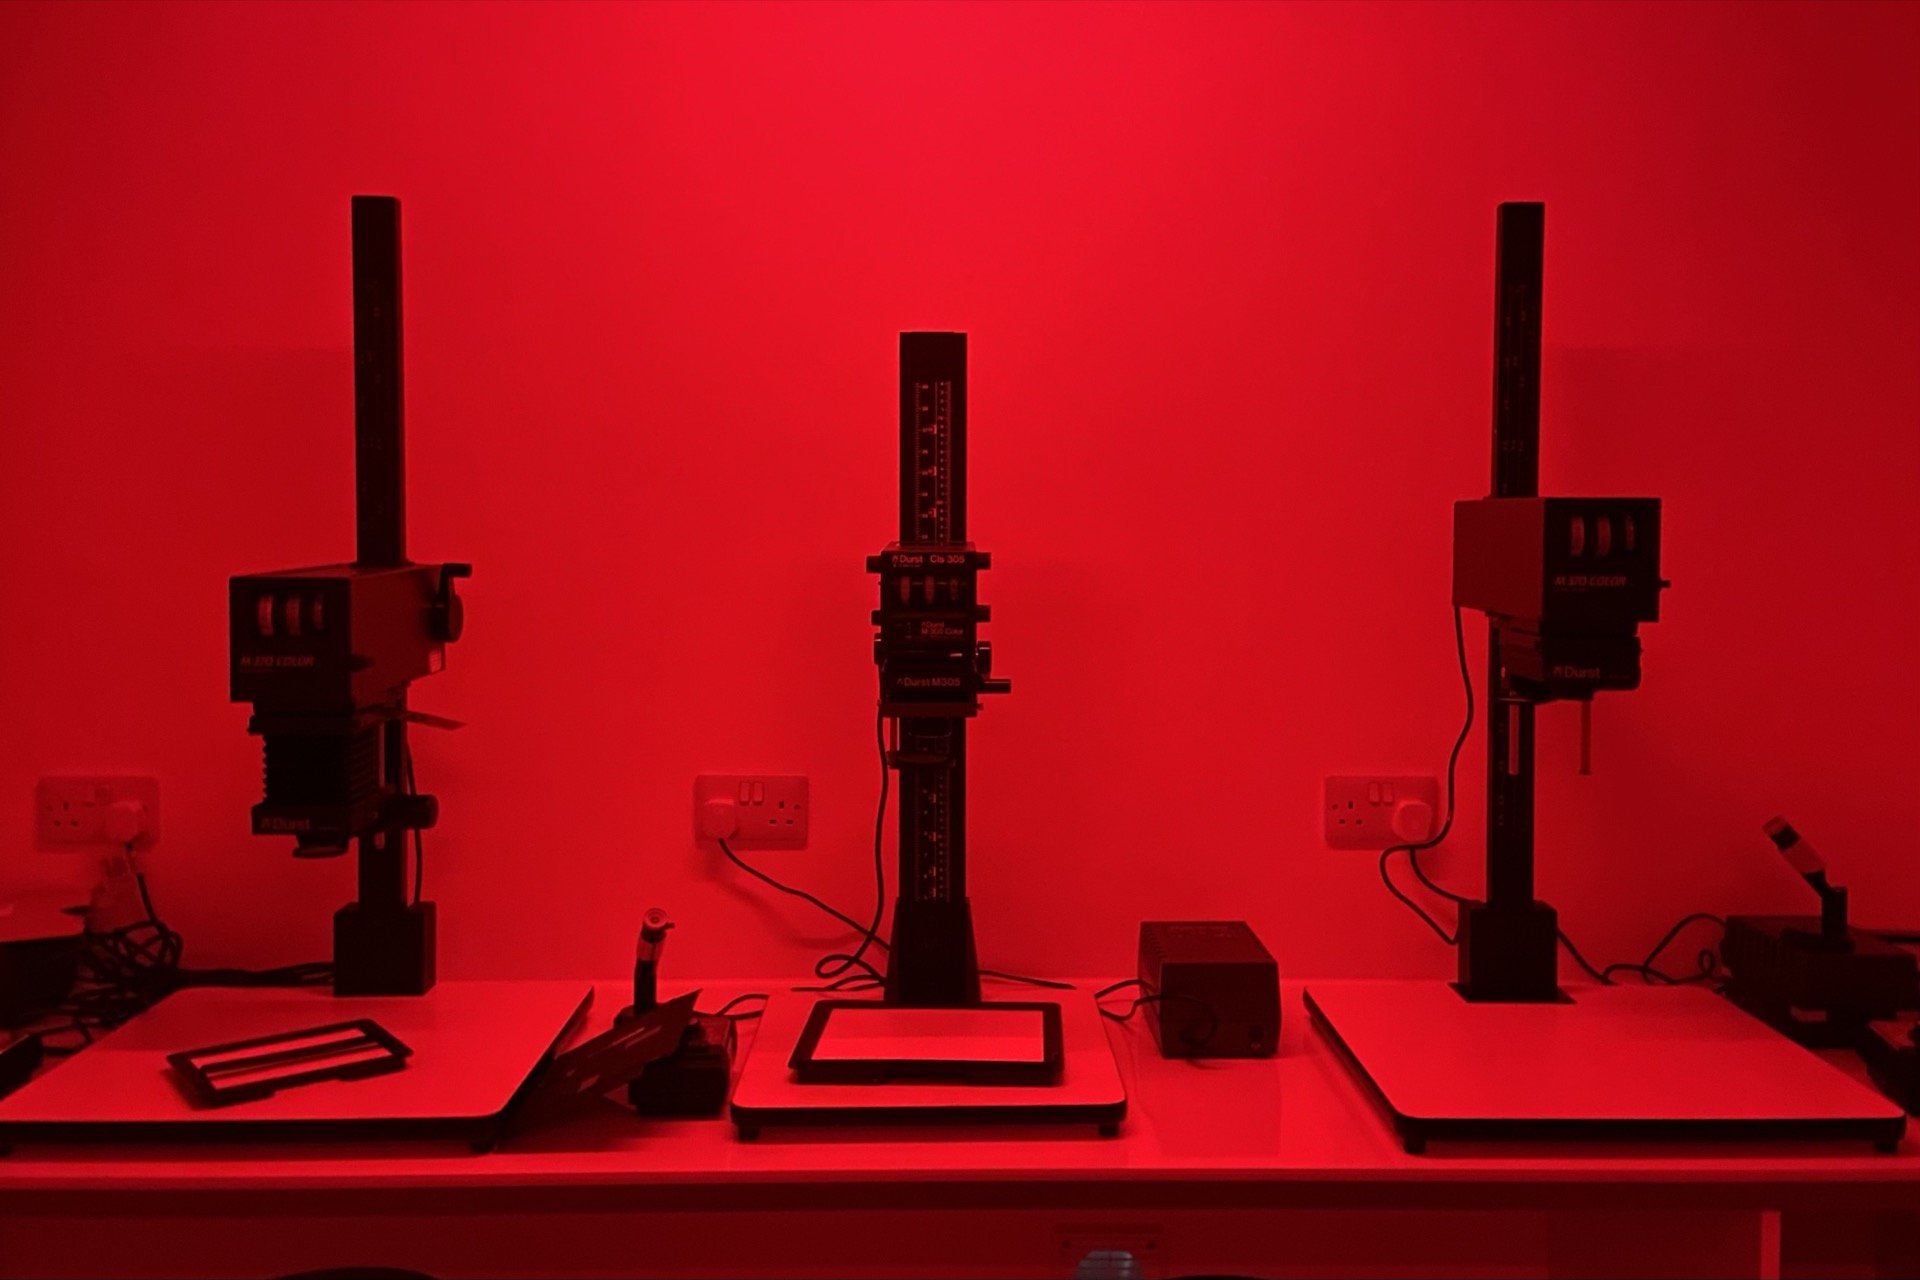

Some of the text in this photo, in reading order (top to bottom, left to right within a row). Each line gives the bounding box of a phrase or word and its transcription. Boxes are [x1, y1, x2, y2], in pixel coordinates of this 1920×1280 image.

[899, 554, 923, 564] Durst
[1564, 665, 1601, 679] Durst
[903, 677, 930, 687] Durst
